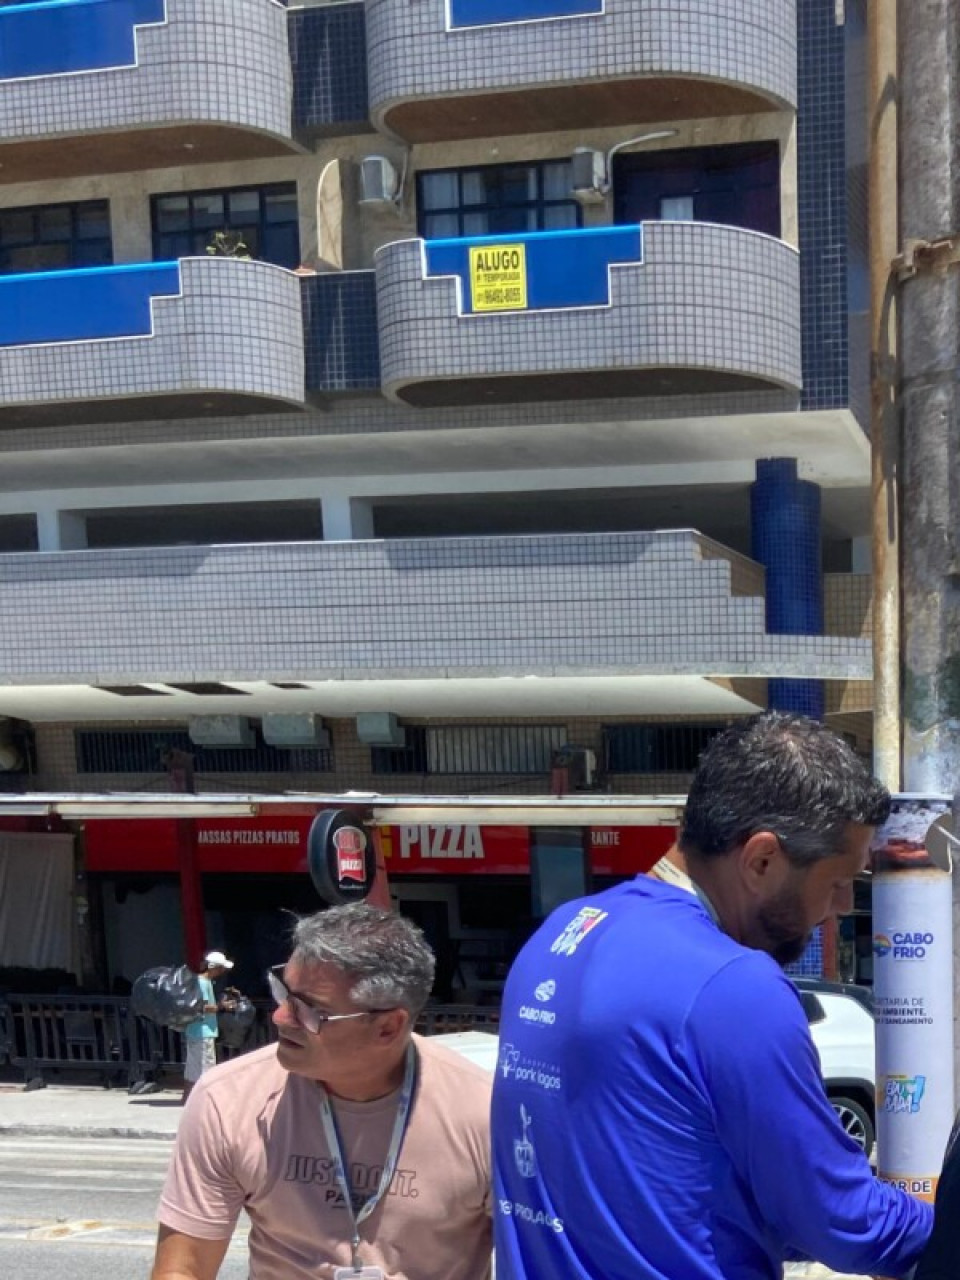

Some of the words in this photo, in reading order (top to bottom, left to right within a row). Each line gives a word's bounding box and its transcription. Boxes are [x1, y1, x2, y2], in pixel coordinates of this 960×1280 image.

[476, 250, 520, 272] ALUGO
[233, 830, 264, 844] PIZZAS
[265, 830, 300, 844] PRATOS
[400, 824, 485, 859] PIZZA
[892, 932, 935, 946] CABO
[893, 946, 927, 959] FRIO
[911, 998, 924, 1006] DE
[911, 1181, 931, 1193] DE
